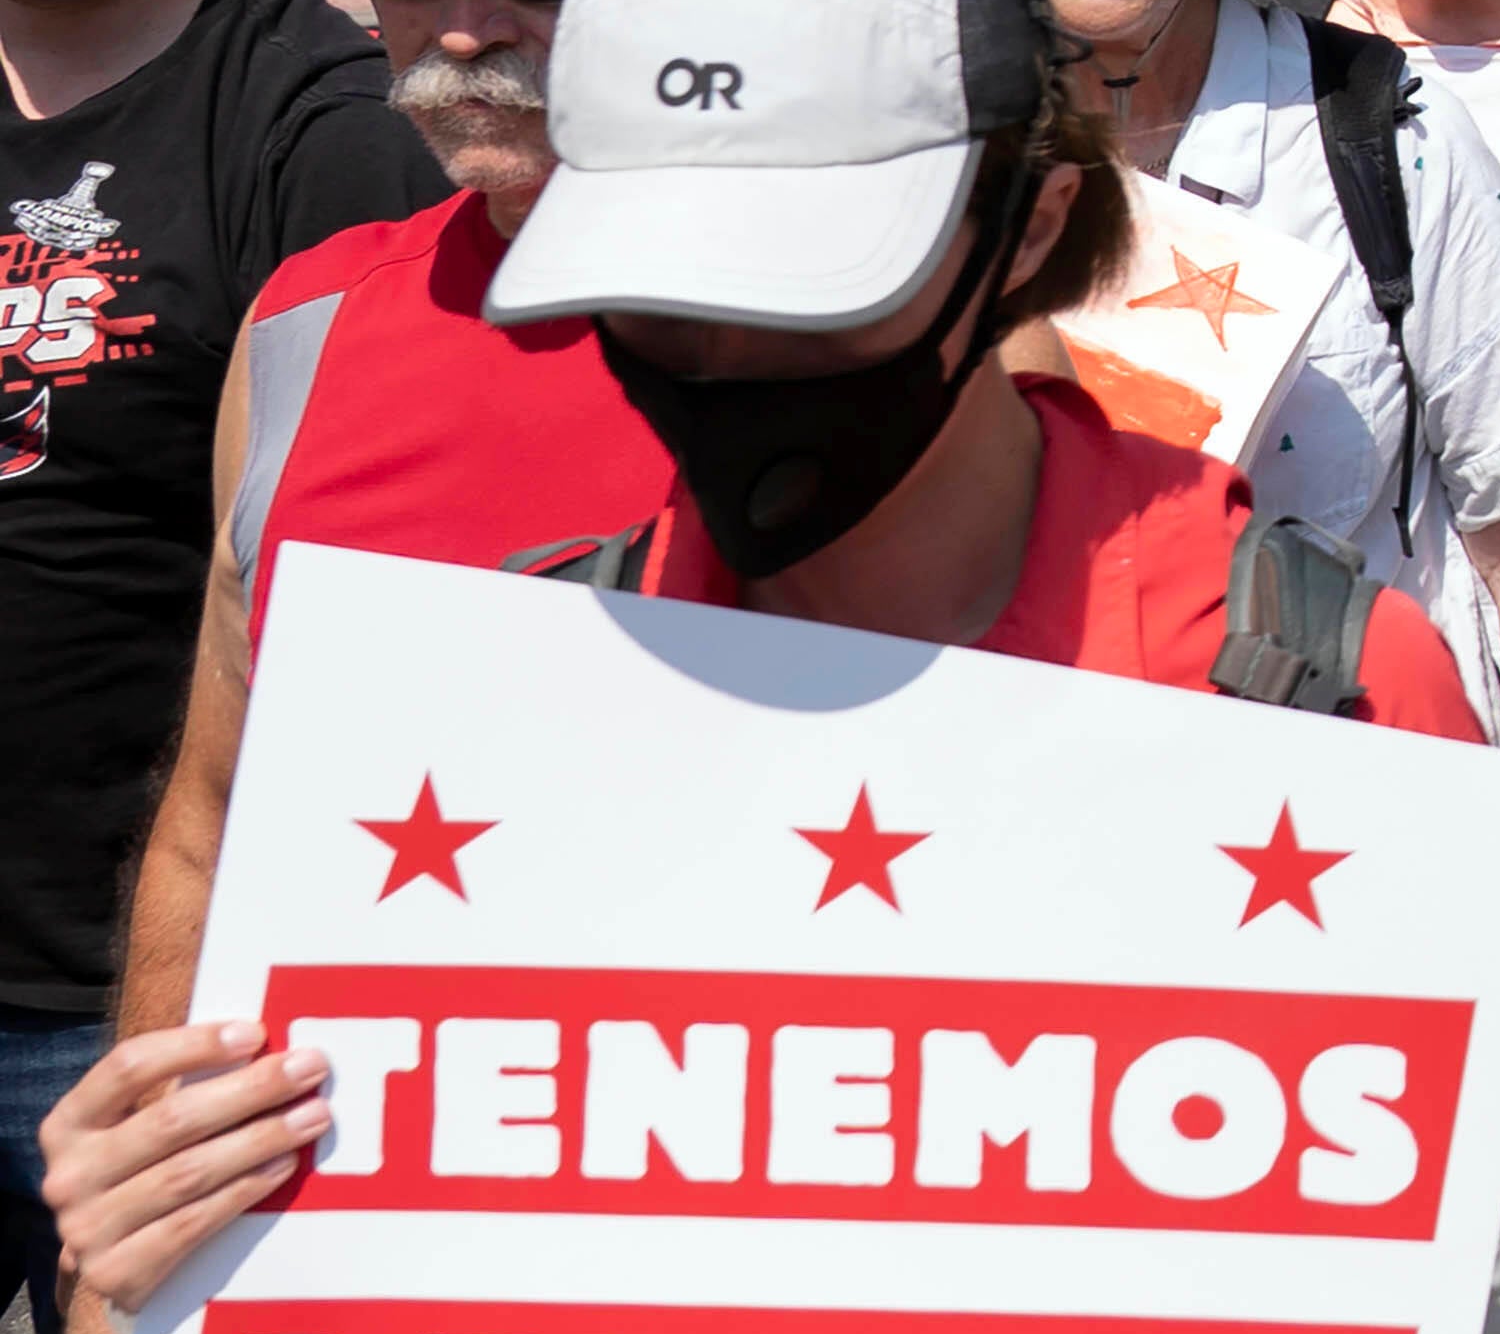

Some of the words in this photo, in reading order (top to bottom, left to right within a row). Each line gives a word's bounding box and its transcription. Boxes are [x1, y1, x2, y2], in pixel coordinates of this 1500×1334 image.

[656, 57, 743, 111] OR
[13, 200, 118, 234] CHAMPIONS
[286, 1013, 1422, 1210] TENEMOS
